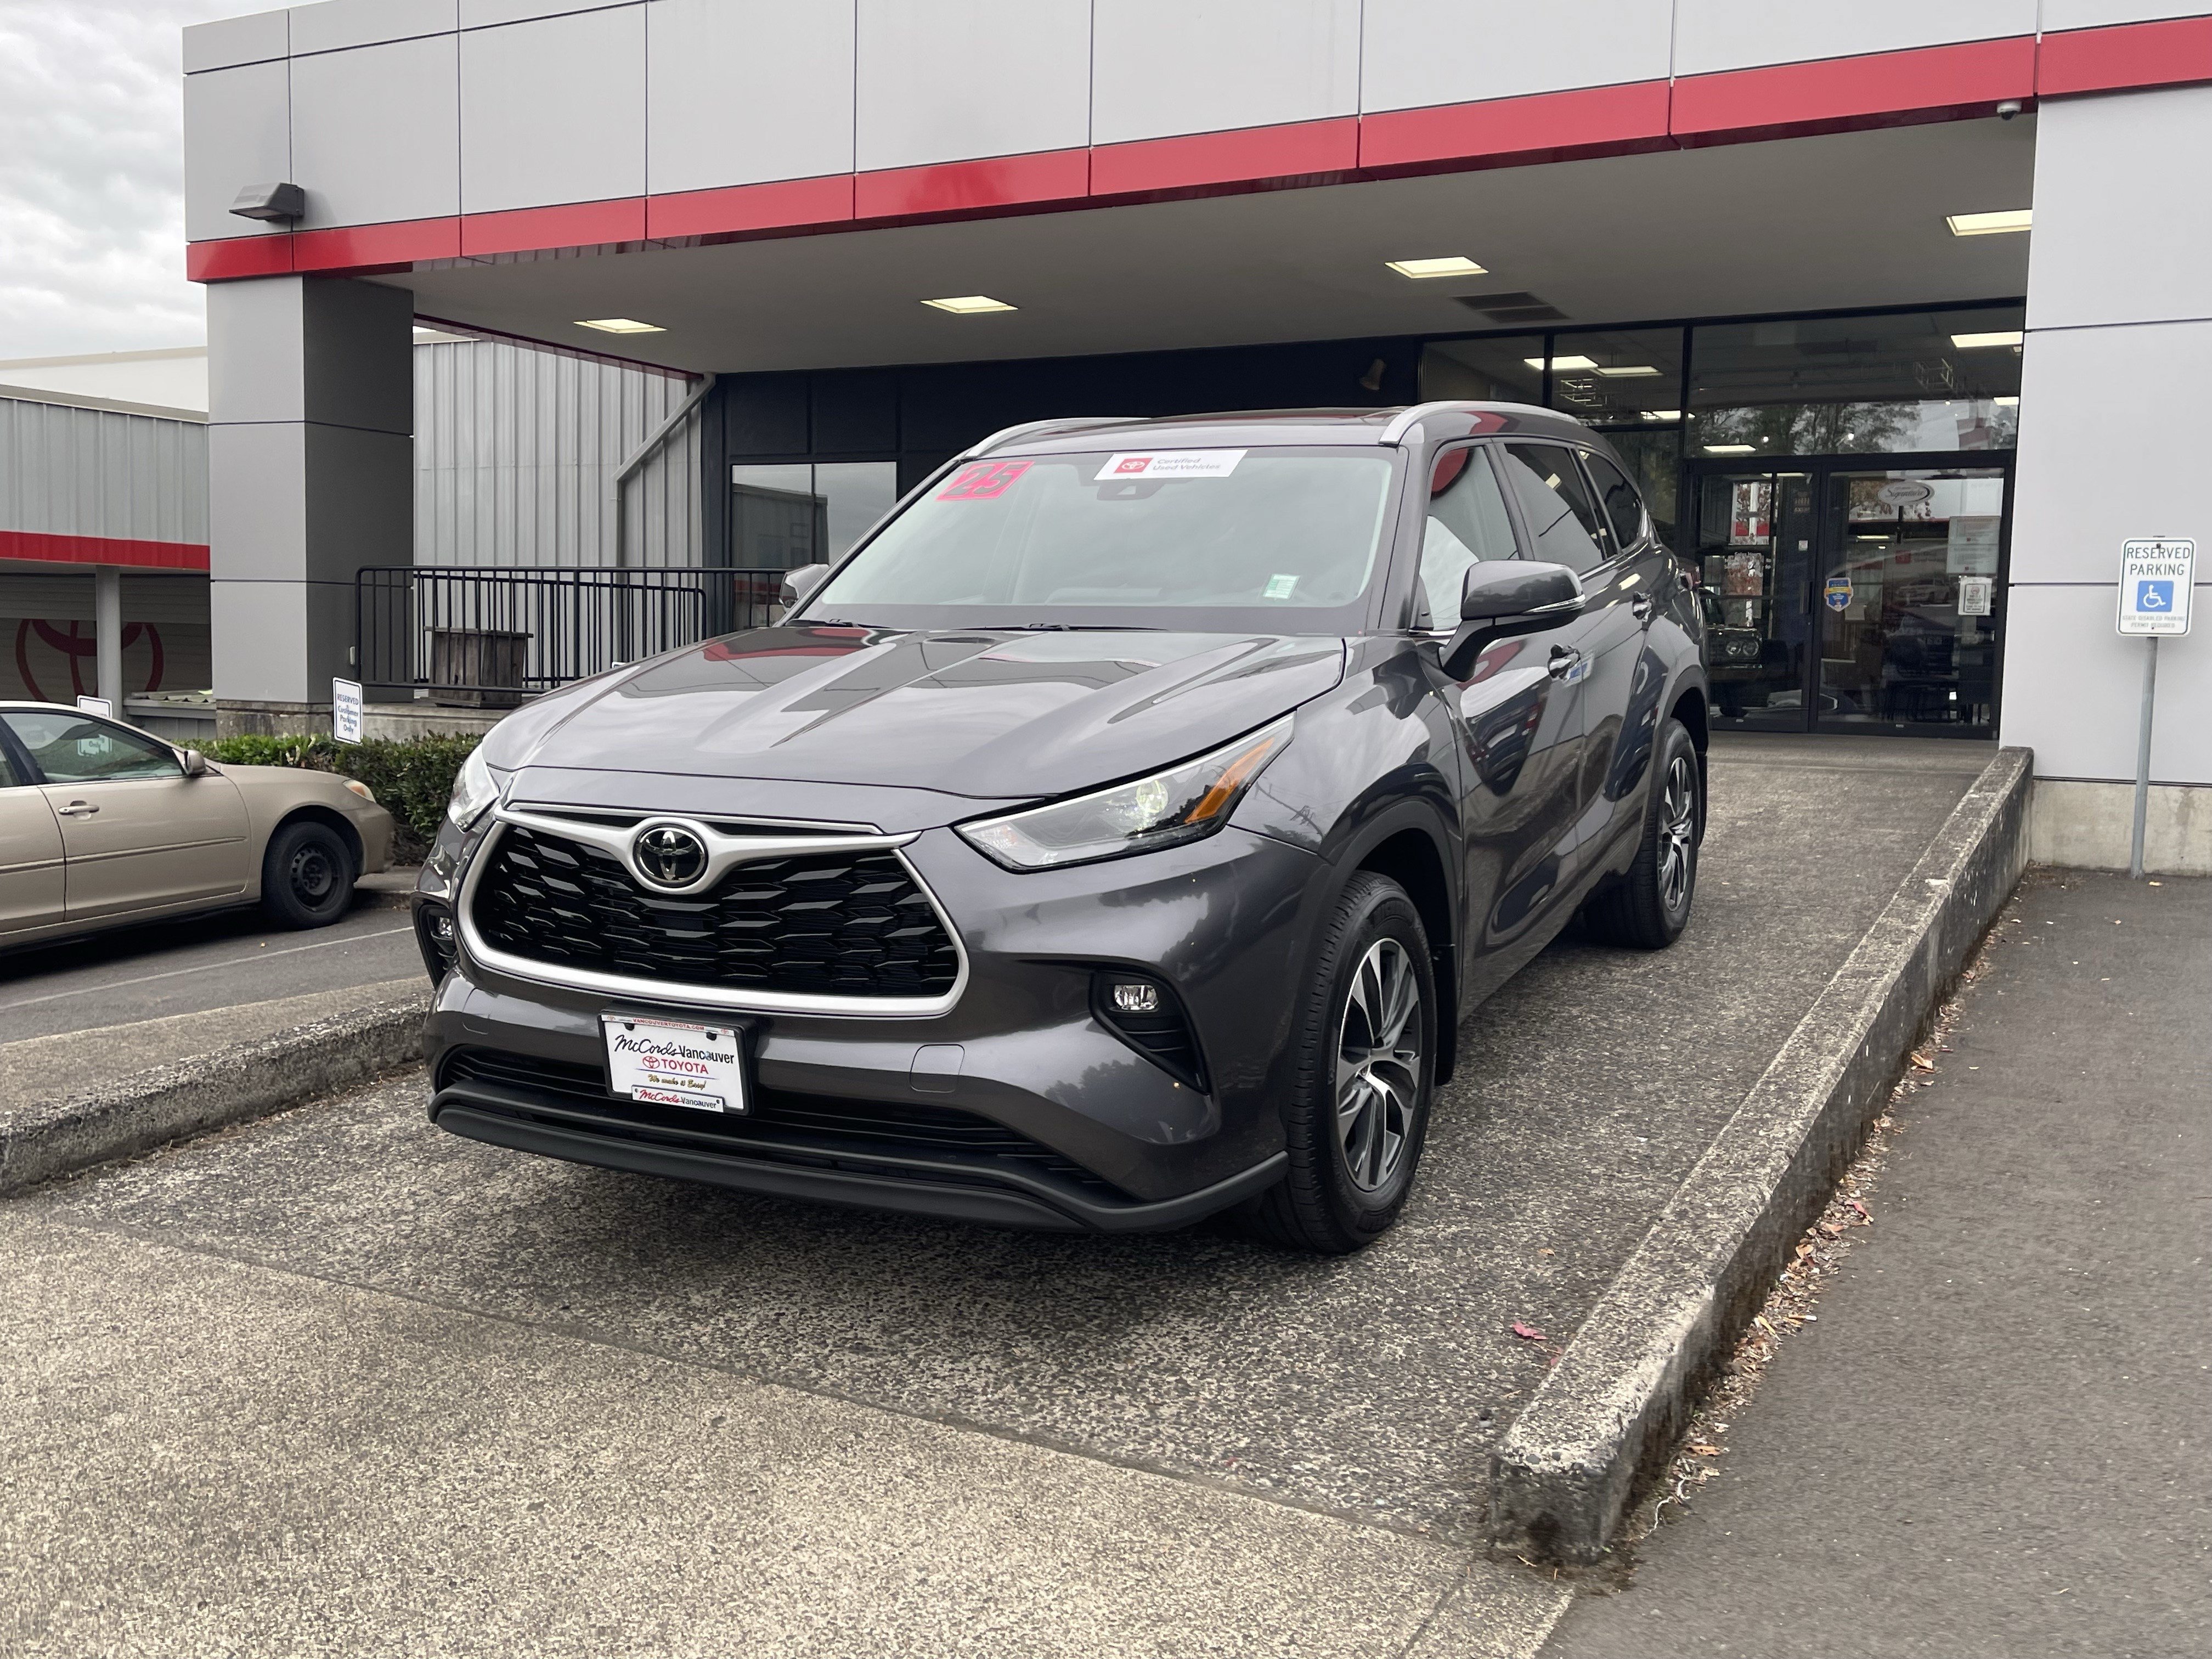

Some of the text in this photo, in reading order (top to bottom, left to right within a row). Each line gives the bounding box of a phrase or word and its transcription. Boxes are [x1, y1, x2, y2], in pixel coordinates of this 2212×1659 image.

[943, 464, 1027, 496] 25
[2126, 547, 2191, 559] RESERVED
[2130, 563, 2185, 576] PARKING
[337, 693, 359, 706] RESERVED
[337, 705, 359, 716] Customer
[340, 715, 357, 727] Parking
[343, 724, 354, 735] Only
[632, 1018, 706, 1031] VANCOUVERTOYOTA.COM
[662, 1058, 709, 1075] TOYOTA
